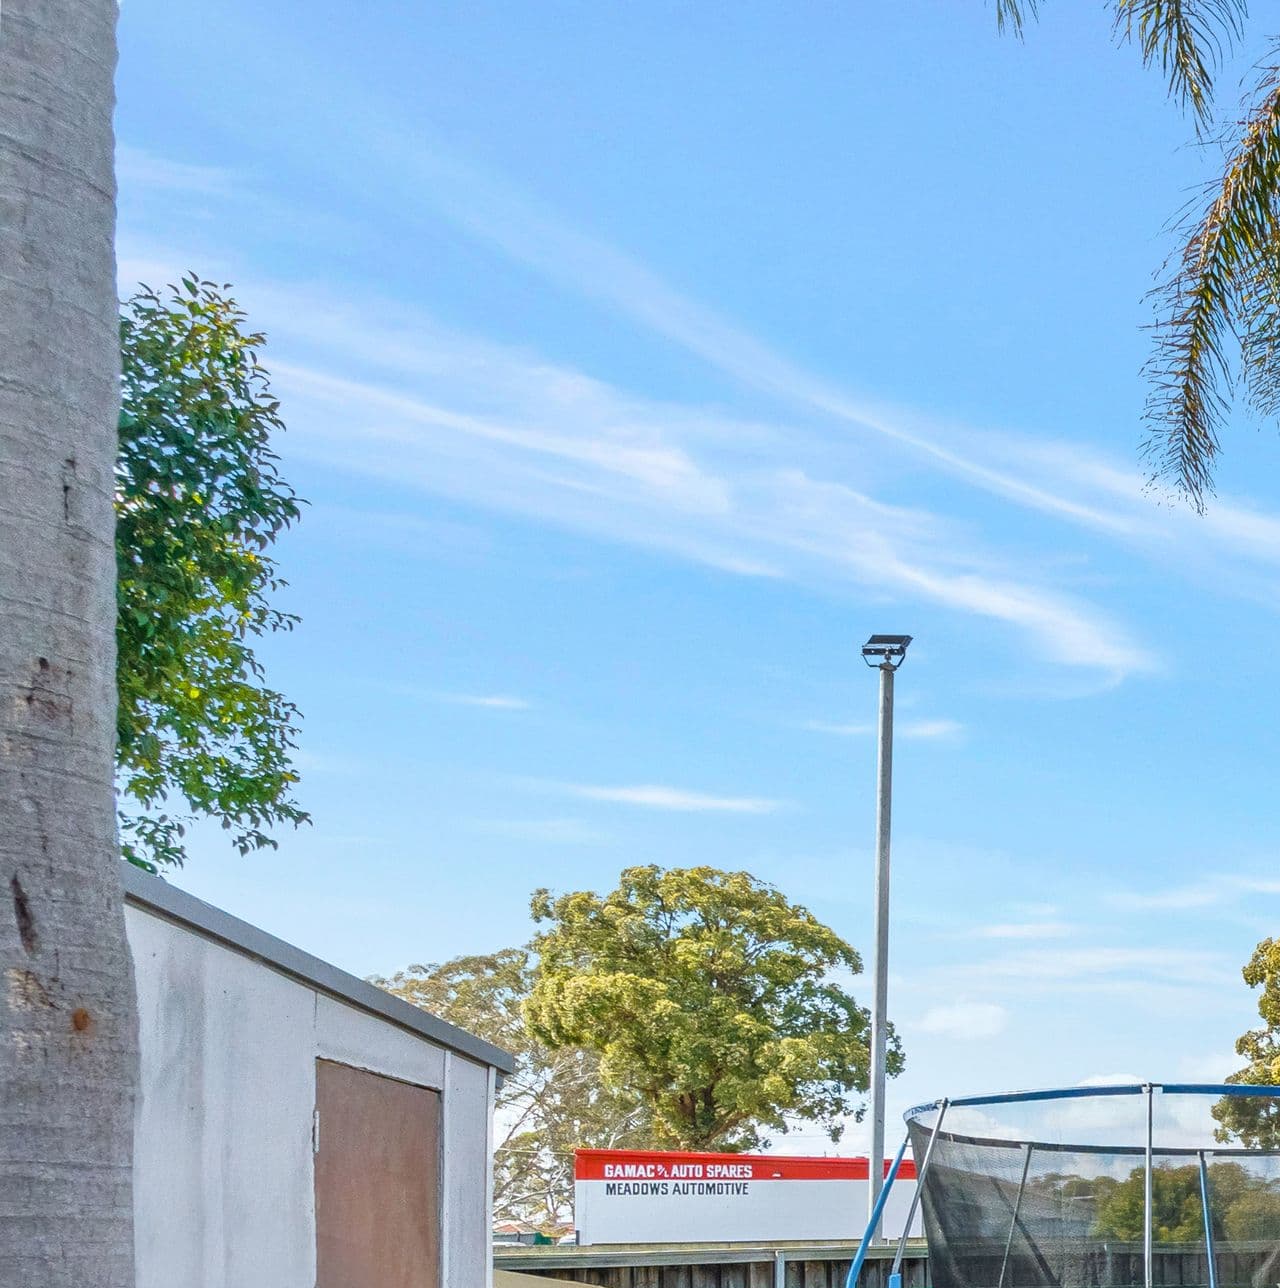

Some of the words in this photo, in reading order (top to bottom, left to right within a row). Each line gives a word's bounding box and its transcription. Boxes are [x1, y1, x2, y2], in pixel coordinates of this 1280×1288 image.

[604, 1164, 655, 1178] GAMAC
[671, 1164, 703, 1178] AUTO
[706, 1164, 752, 1178] SPARES
[606, 1182, 668, 1195] MEADOWS
[672, 1182, 749, 1195] AUTOMOTIVE
